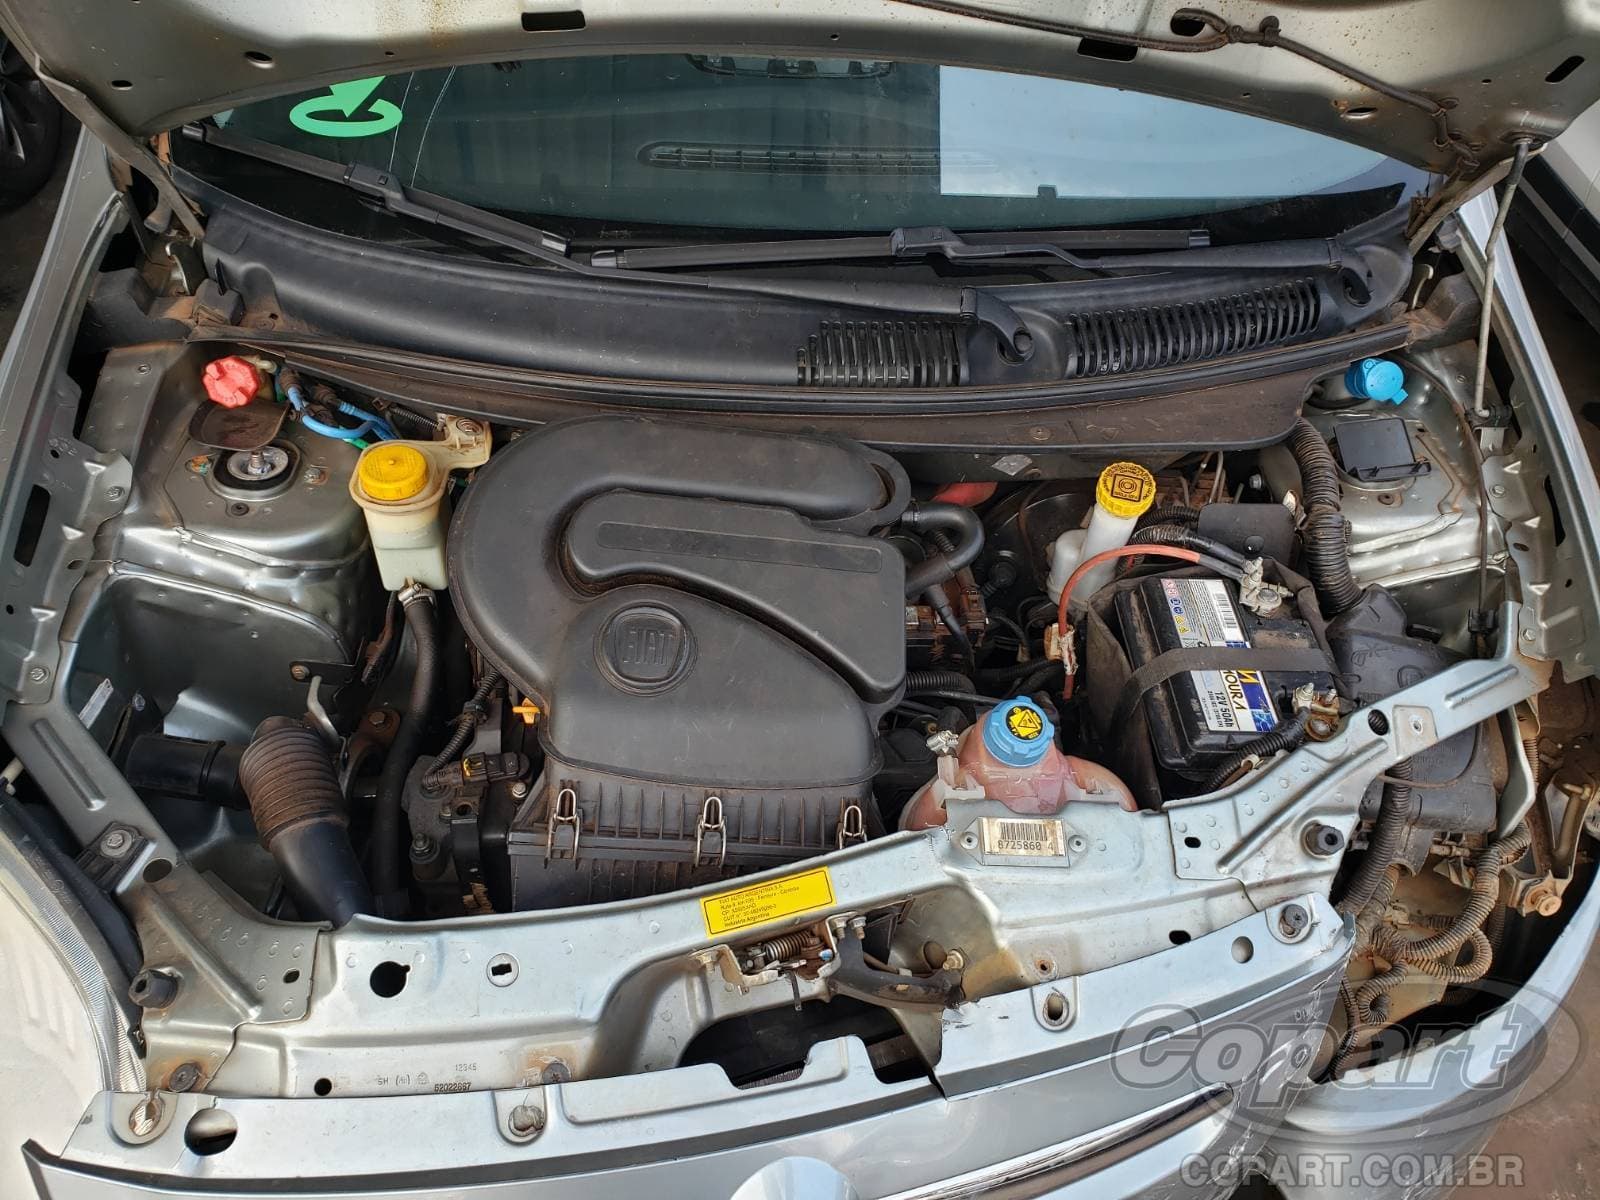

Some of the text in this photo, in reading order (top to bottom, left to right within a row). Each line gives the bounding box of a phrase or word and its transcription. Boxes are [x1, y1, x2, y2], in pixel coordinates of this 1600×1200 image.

[623, 630, 674, 664] FIAT
[1214, 691, 1234, 728] 12V 50Ah
[997, 839, 1042, 851] 8725860
